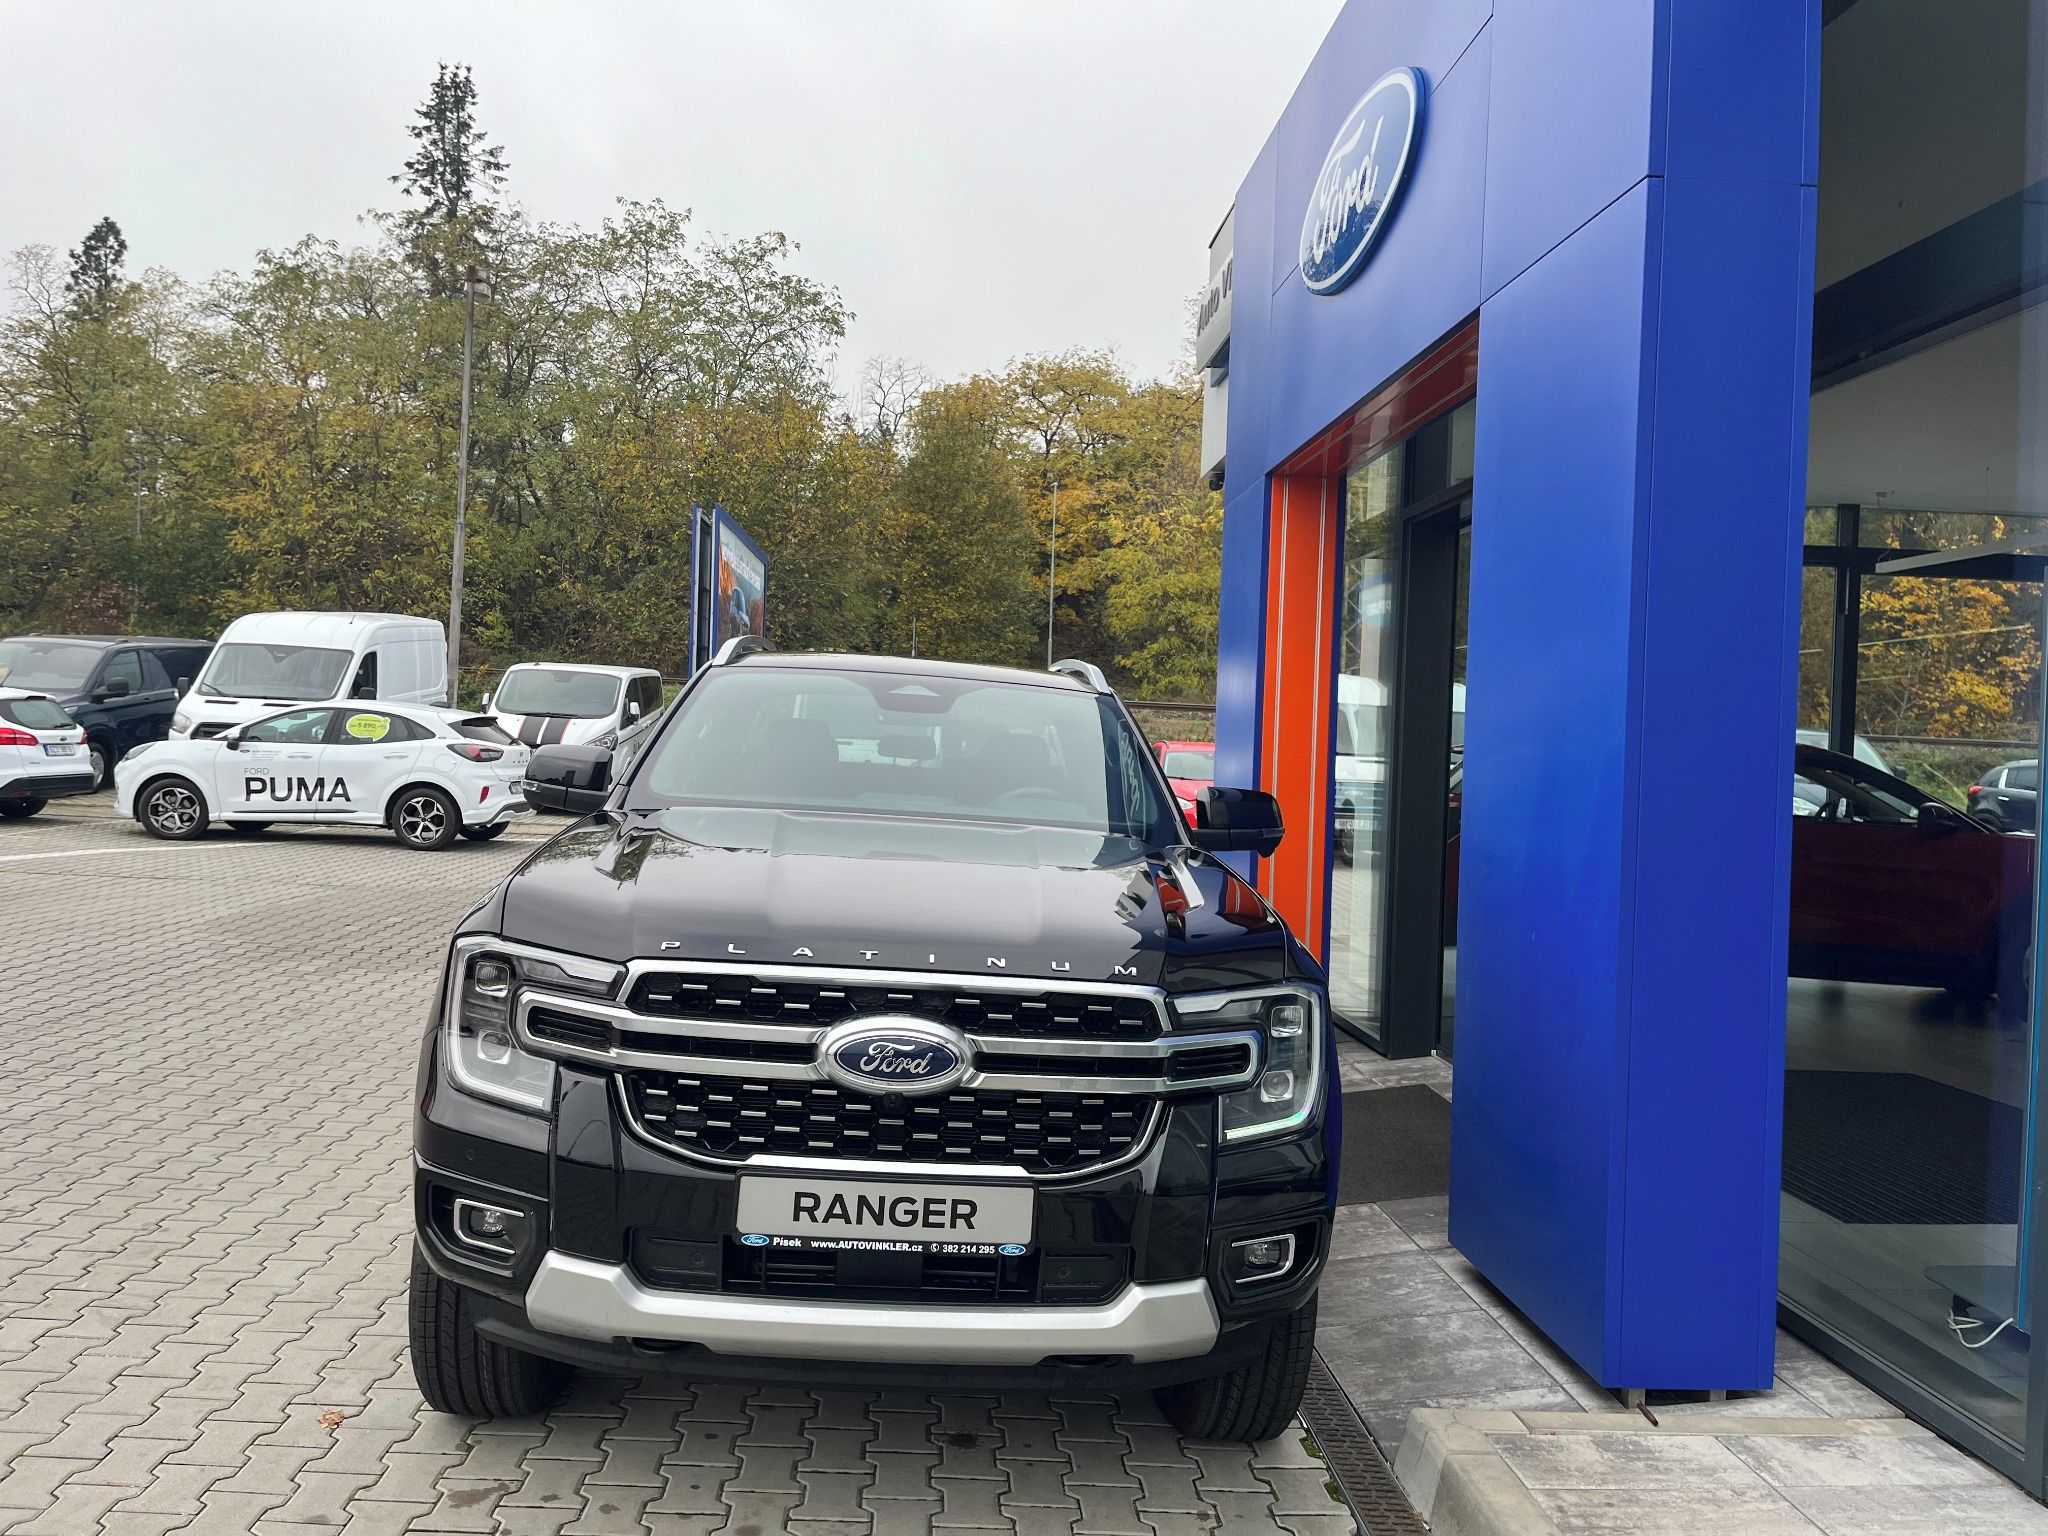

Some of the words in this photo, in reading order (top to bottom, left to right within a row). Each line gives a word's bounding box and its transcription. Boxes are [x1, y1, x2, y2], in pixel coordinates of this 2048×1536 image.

[1313, 115, 1384, 264] Ford
[1197, 286, 1220, 337] Auto
[244, 767, 270, 776] FORD
[245, 776, 352, 803] PUMA
[660, 941, 1137, 976] PLATINUM
[859, 1041, 933, 1075] Ford
[792, 1191, 978, 1230] RANGER
[772, 1236, 802, 1248] Písek
[810, 1240, 923, 1252] www.AUTOVINKLER.cz
[942, 1244, 959, 1253] 382
[960, 1244, 977, 1254] 214
[978, 1245, 995, 1254] 295
